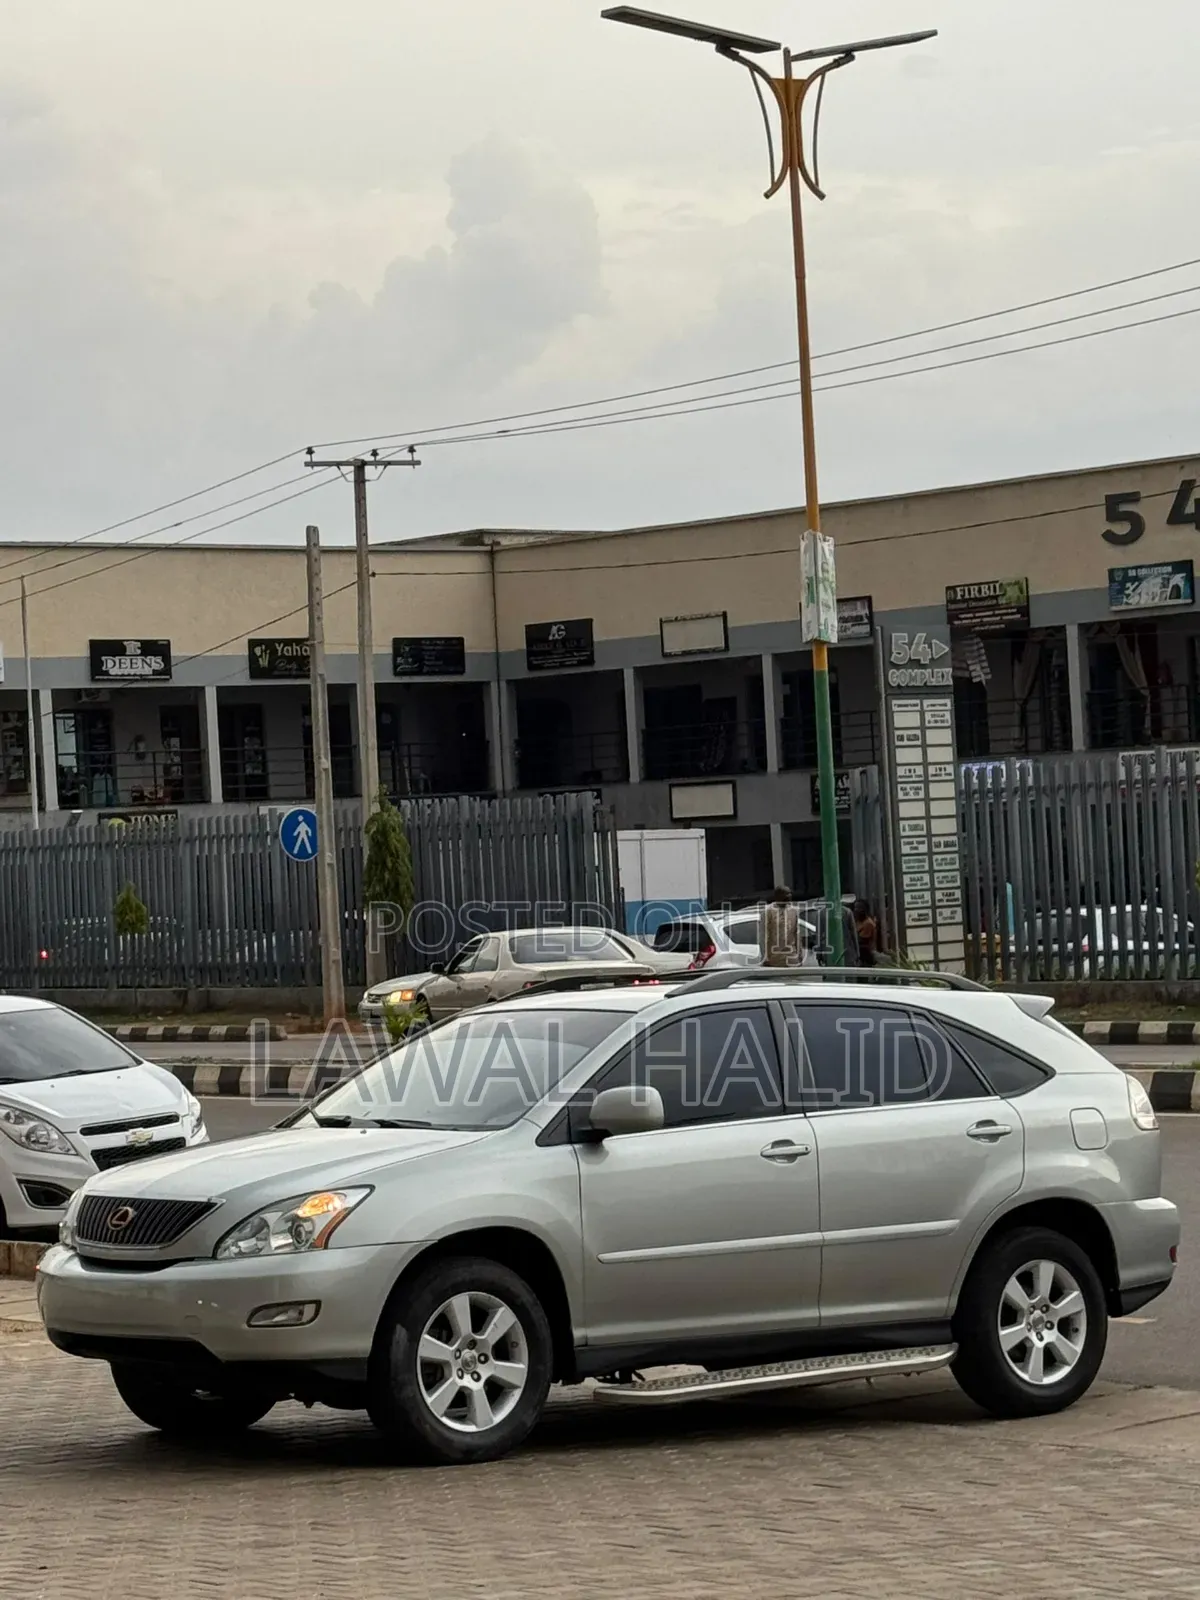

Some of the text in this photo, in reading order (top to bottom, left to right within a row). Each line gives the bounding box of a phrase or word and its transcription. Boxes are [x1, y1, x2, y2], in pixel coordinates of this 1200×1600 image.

[956, 583, 1004, 599] FIRBIL
[890, 632, 931, 665] 54
[101, 656, 164, 671] DEENS
[888, 667, 953, 687] COMPLEX
